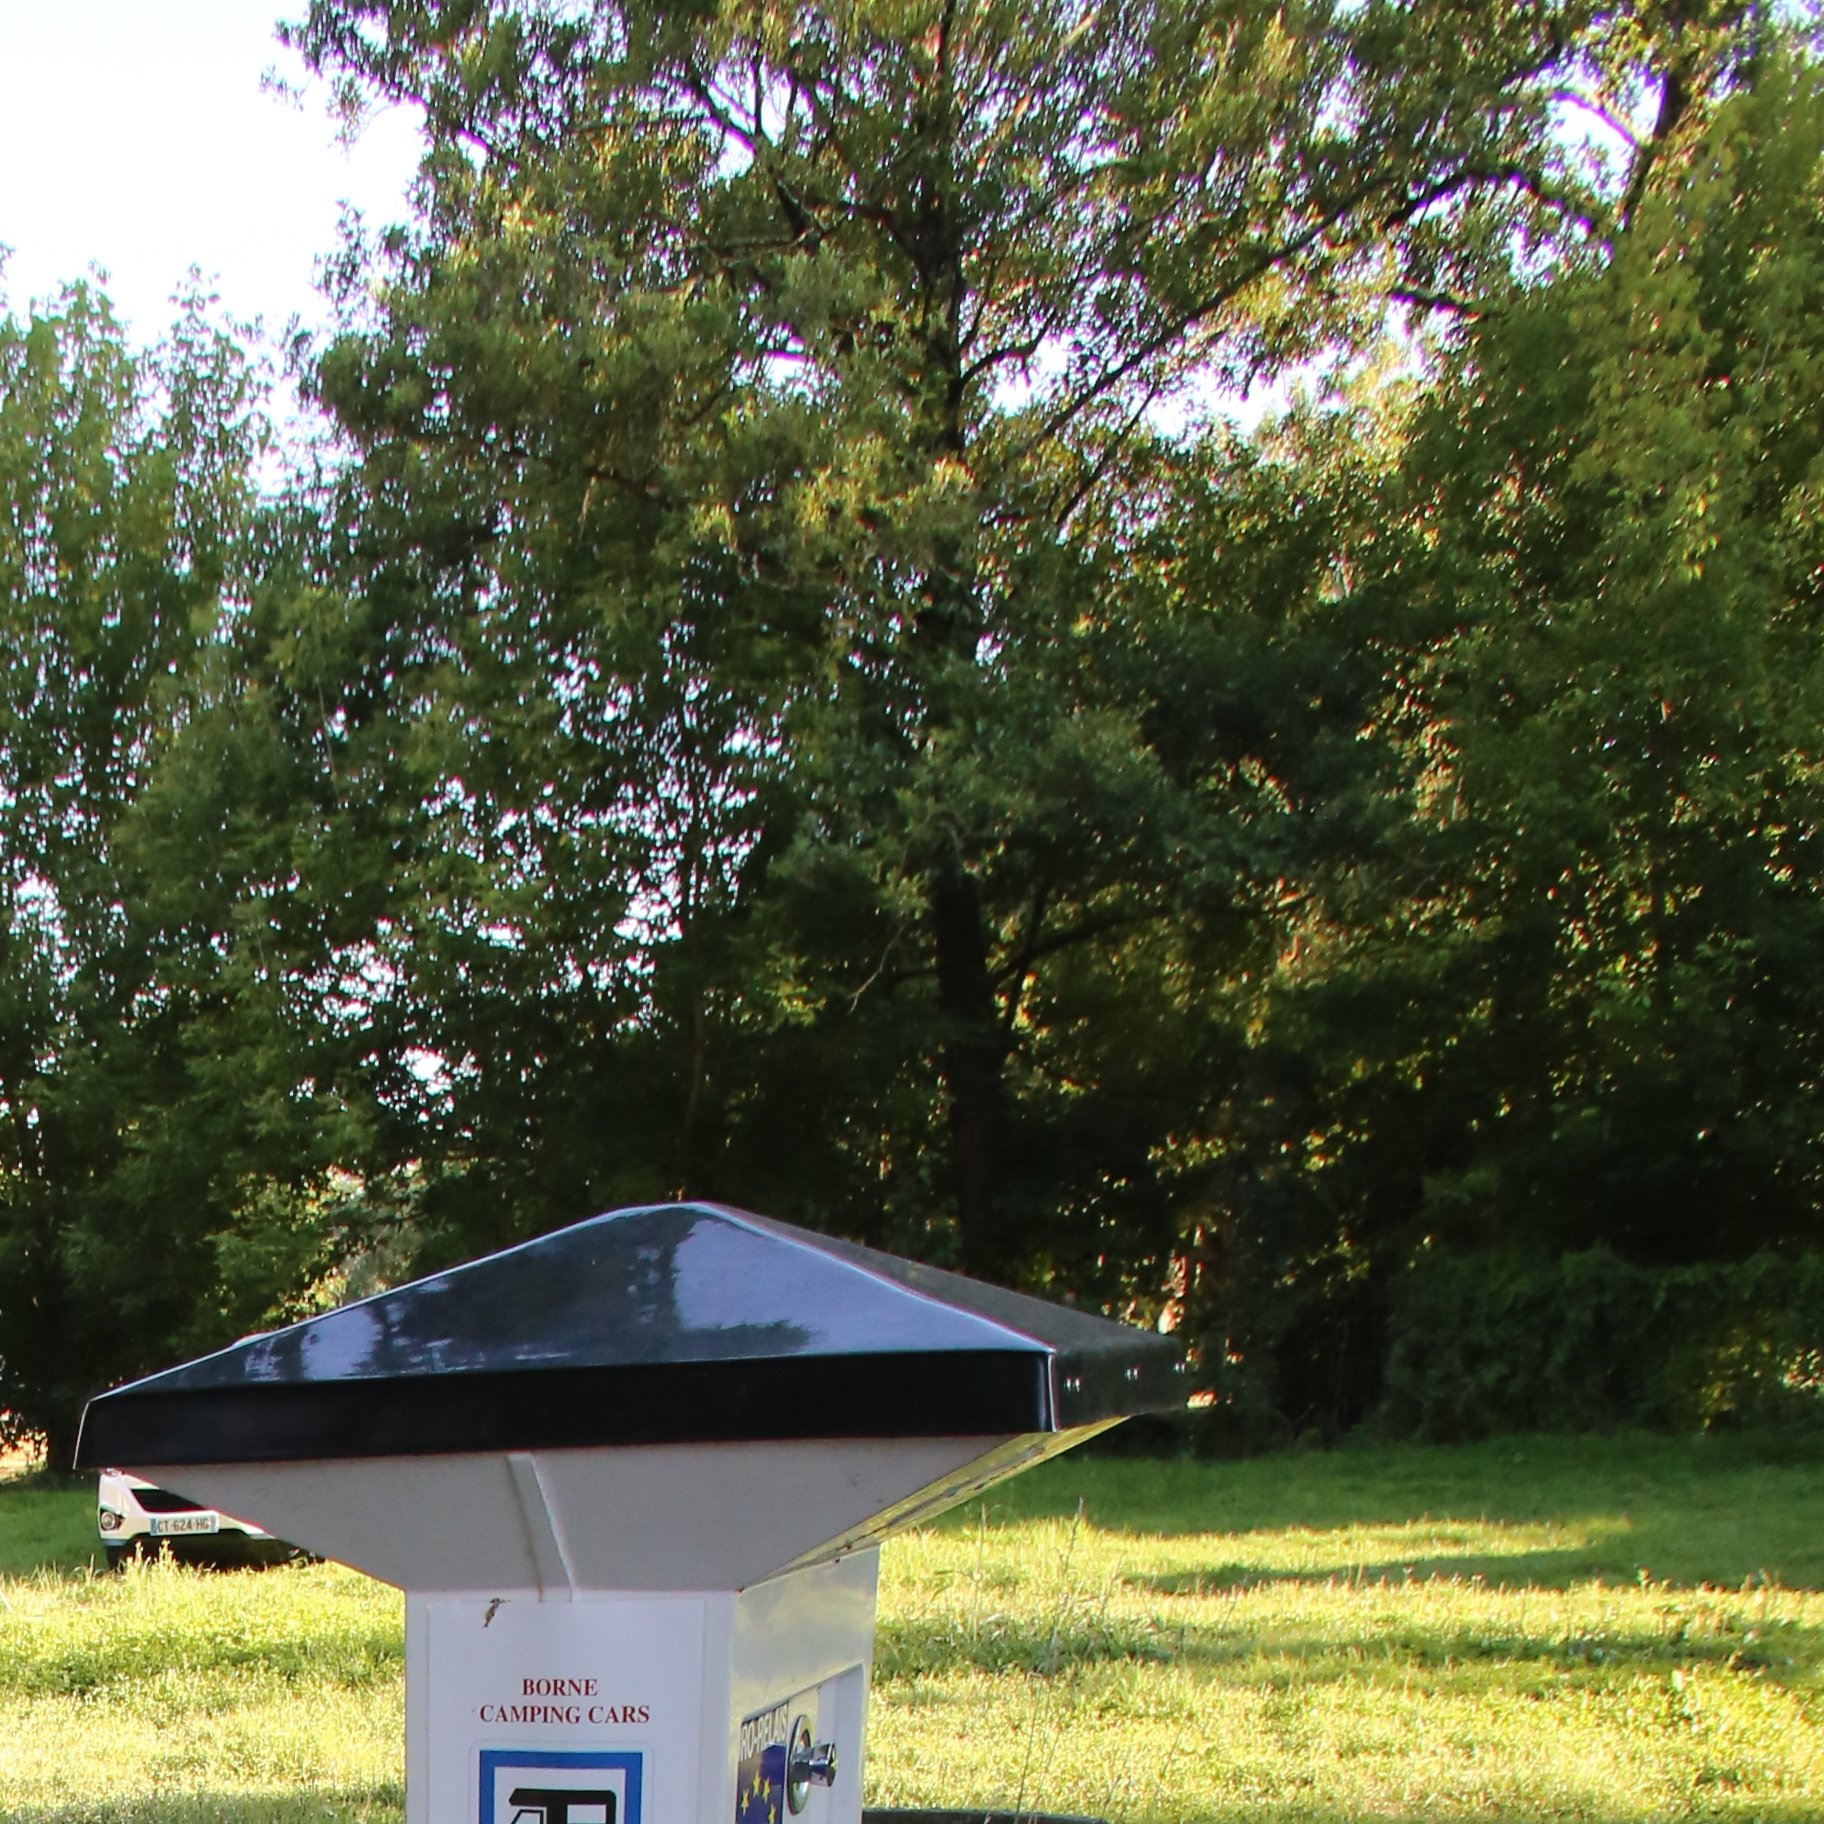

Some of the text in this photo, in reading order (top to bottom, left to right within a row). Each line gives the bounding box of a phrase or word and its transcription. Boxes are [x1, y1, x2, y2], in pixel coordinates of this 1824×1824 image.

[522, 1678, 598, 1697] BORNE
[479, 1704, 650, 1725] CAMPING CARS
